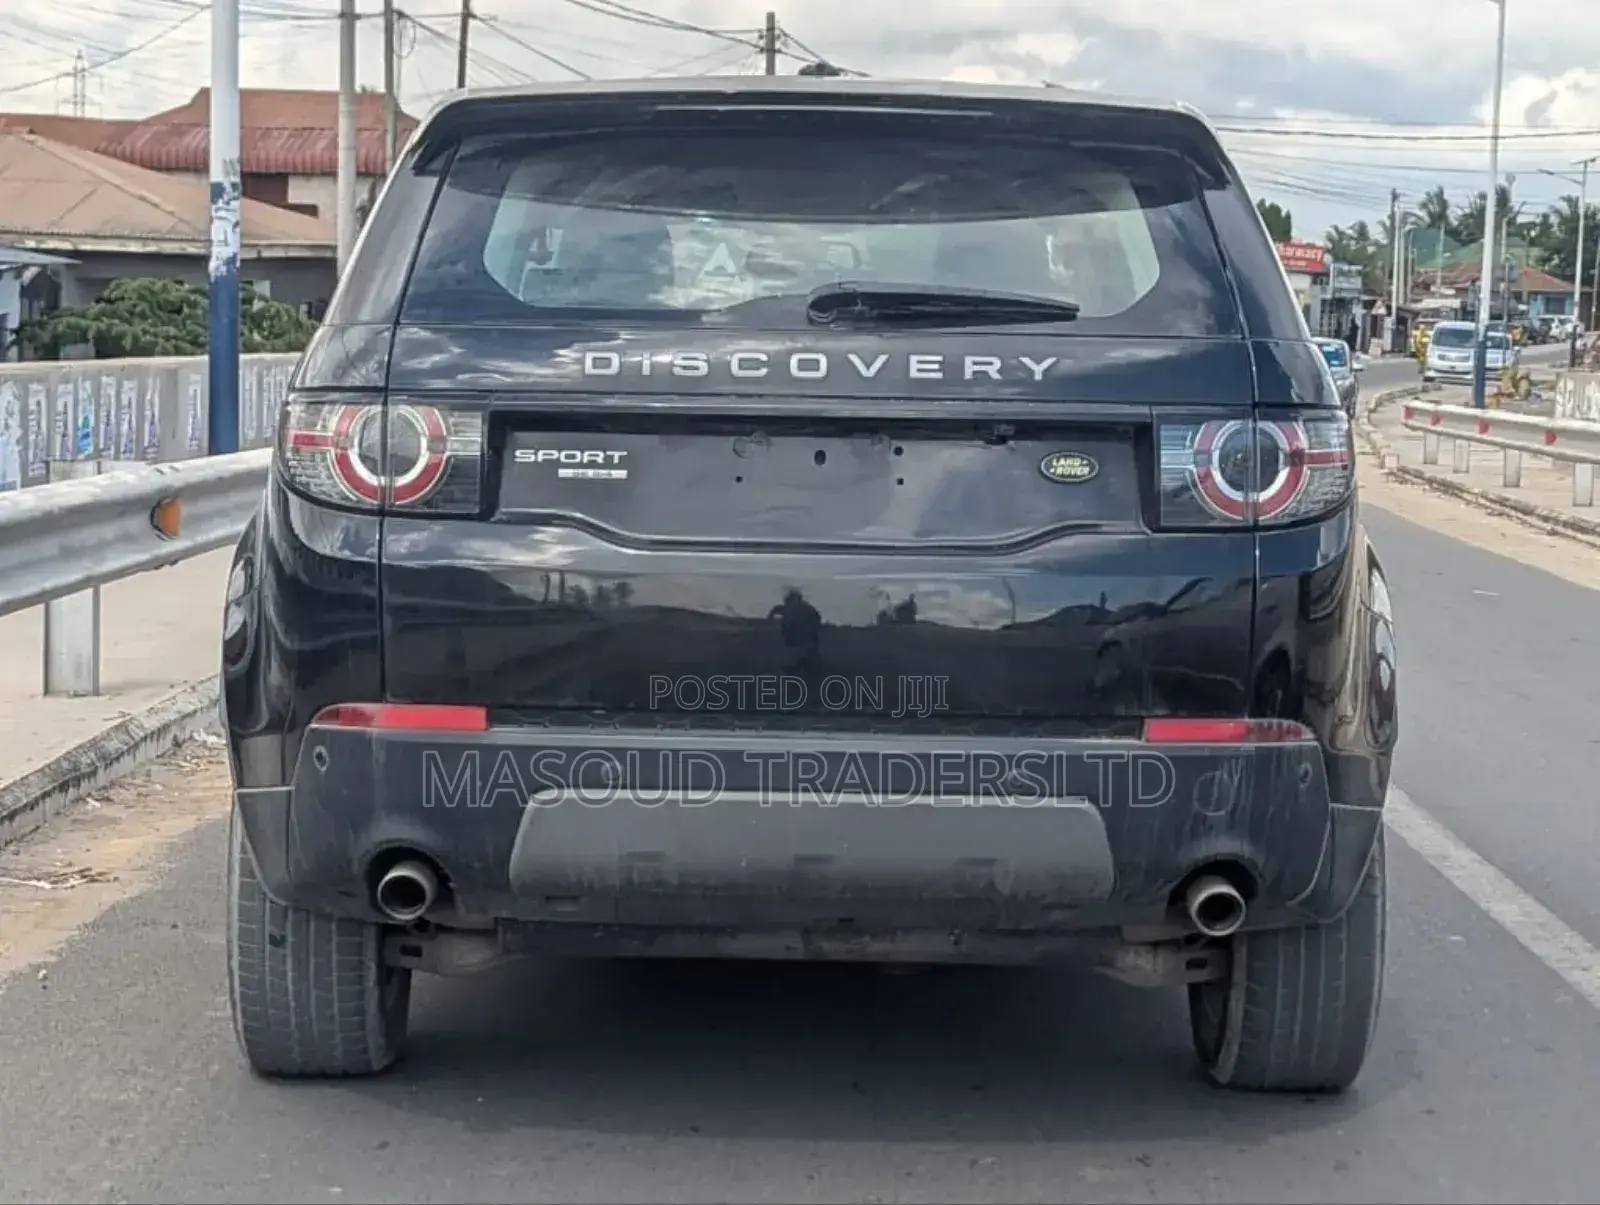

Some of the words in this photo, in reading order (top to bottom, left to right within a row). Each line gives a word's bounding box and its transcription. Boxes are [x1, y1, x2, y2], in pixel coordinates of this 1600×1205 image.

[584, 350, 1058, 381] DISCOVERY
[514, 449, 628, 464] SPORT
[1051, 457, 1081, 466] LAND
[1055, 466, 1090, 476] ROVER
